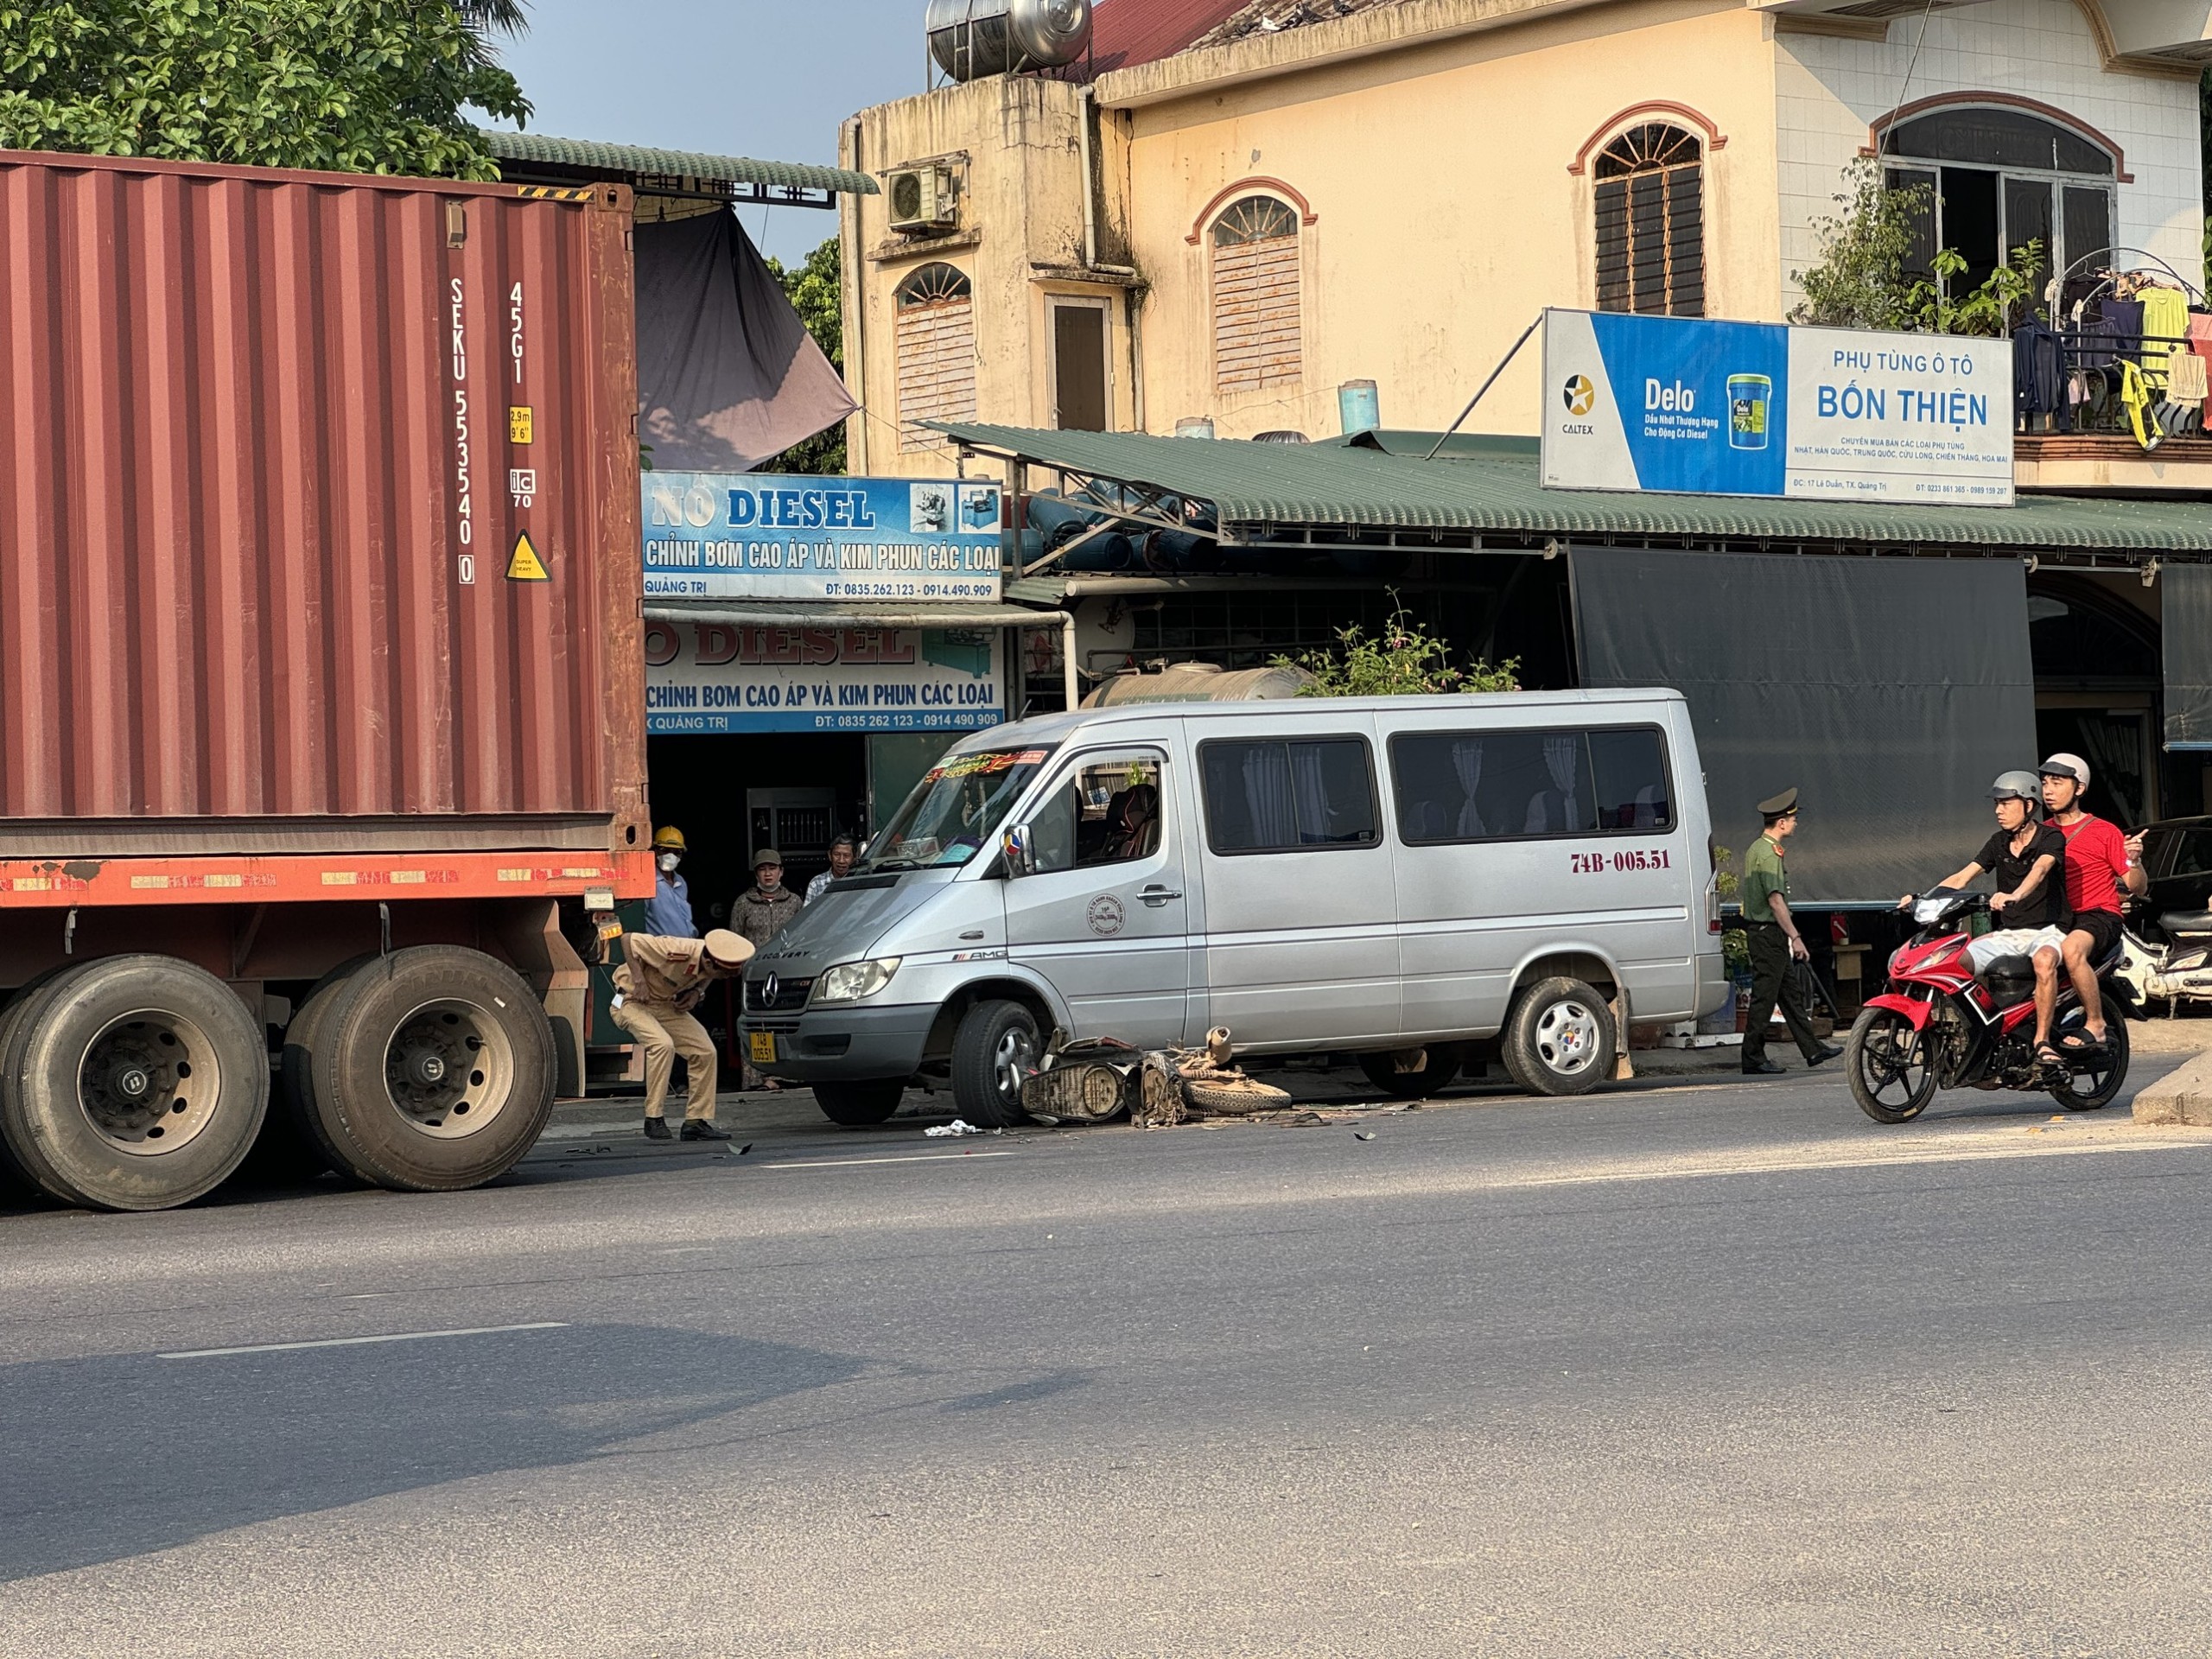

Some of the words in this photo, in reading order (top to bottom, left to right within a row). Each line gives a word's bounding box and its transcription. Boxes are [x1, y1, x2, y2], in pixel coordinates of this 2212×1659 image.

[451, 277, 465, 381] SEKU
[510, 282, 523, 384] 45G1
[1834, 350, 1871, 373] PHỤ
[1877, 349, 1927, 372] TÙNG
[1932, 352, 1945, 373] Ô
[1949, 353, 1973, 375] TÔ
[1645, 378, 1694, 412] Delo
[1818, 379, 1885, 420] BỐN
[1897, 387, 1987, 433] THIỆN
[1562, 423, 1593, 435] CALTEX
[1676, 415, 1700, 428] Thượng
[1701, 416, 1719, 429] Hạng
[1644, 426, 1657, 436] Cho
[1658, 427, 1675, 439] Động
[1687, 429, 1708, 439] Diesel
[1853, 448, 1876, 457] TRUNG
[1900, 439, 1915, 448] CÁC
[455, 390, 471, 545] 553540
[513, 494, 532, 508] 70
[727, 488, 876, 531] DIESEL
[645, 531, 699, 567] CHỈNH
[704, 538, 743, 568] BƠM
[748, 541, 782, 569] CAO
[786, 537, 810, 569] ÁP
[813, 537, 836, 569] VÀ
[840, 543, 873, 570] KIM
[877, 543, 924, 571] PHUN
[927, 539, 960, 571] CÁC
[964, 545, 1000, 576] LOẠI
[645, 576, 687, 594] QUẢNG
[826, 582, 842, 595] ĐT:
[844, 583, 914, 595] 0835.262.123
[923, 584, 992, 595] 0914.490.909
[695, 624, 915, 666] DIESEL
[646, 679, 697, 708] CHỈNH
[702, 684, 741, 707] BƠM
[746, 684, 780, 707] CAO
[785, 680, 807, 707] ÁP
[811, 679, 834, 706] VÀ
[838, 684, 868, 706] KIM
[874, 683, 916, 705] PHUN
[921, 679, 953, 705] CÁC
[958, 683, 993, 709] LOẠI
[656, 715, 704, 729] QUẢNG
[708, 716, 728, 731] TRỊ
[815, 715, 834, 728] ĐT:
[838, 715, 866, 727] 0835
[868, 715, 889, 727] 262
[893, 715, 913, 726] 123
[924, 714, 951, 726] 0914
[954, 714, 974, 725] 490
[977, 714, 997, 725] 909
[970, 950, 1007, 959] AMG
